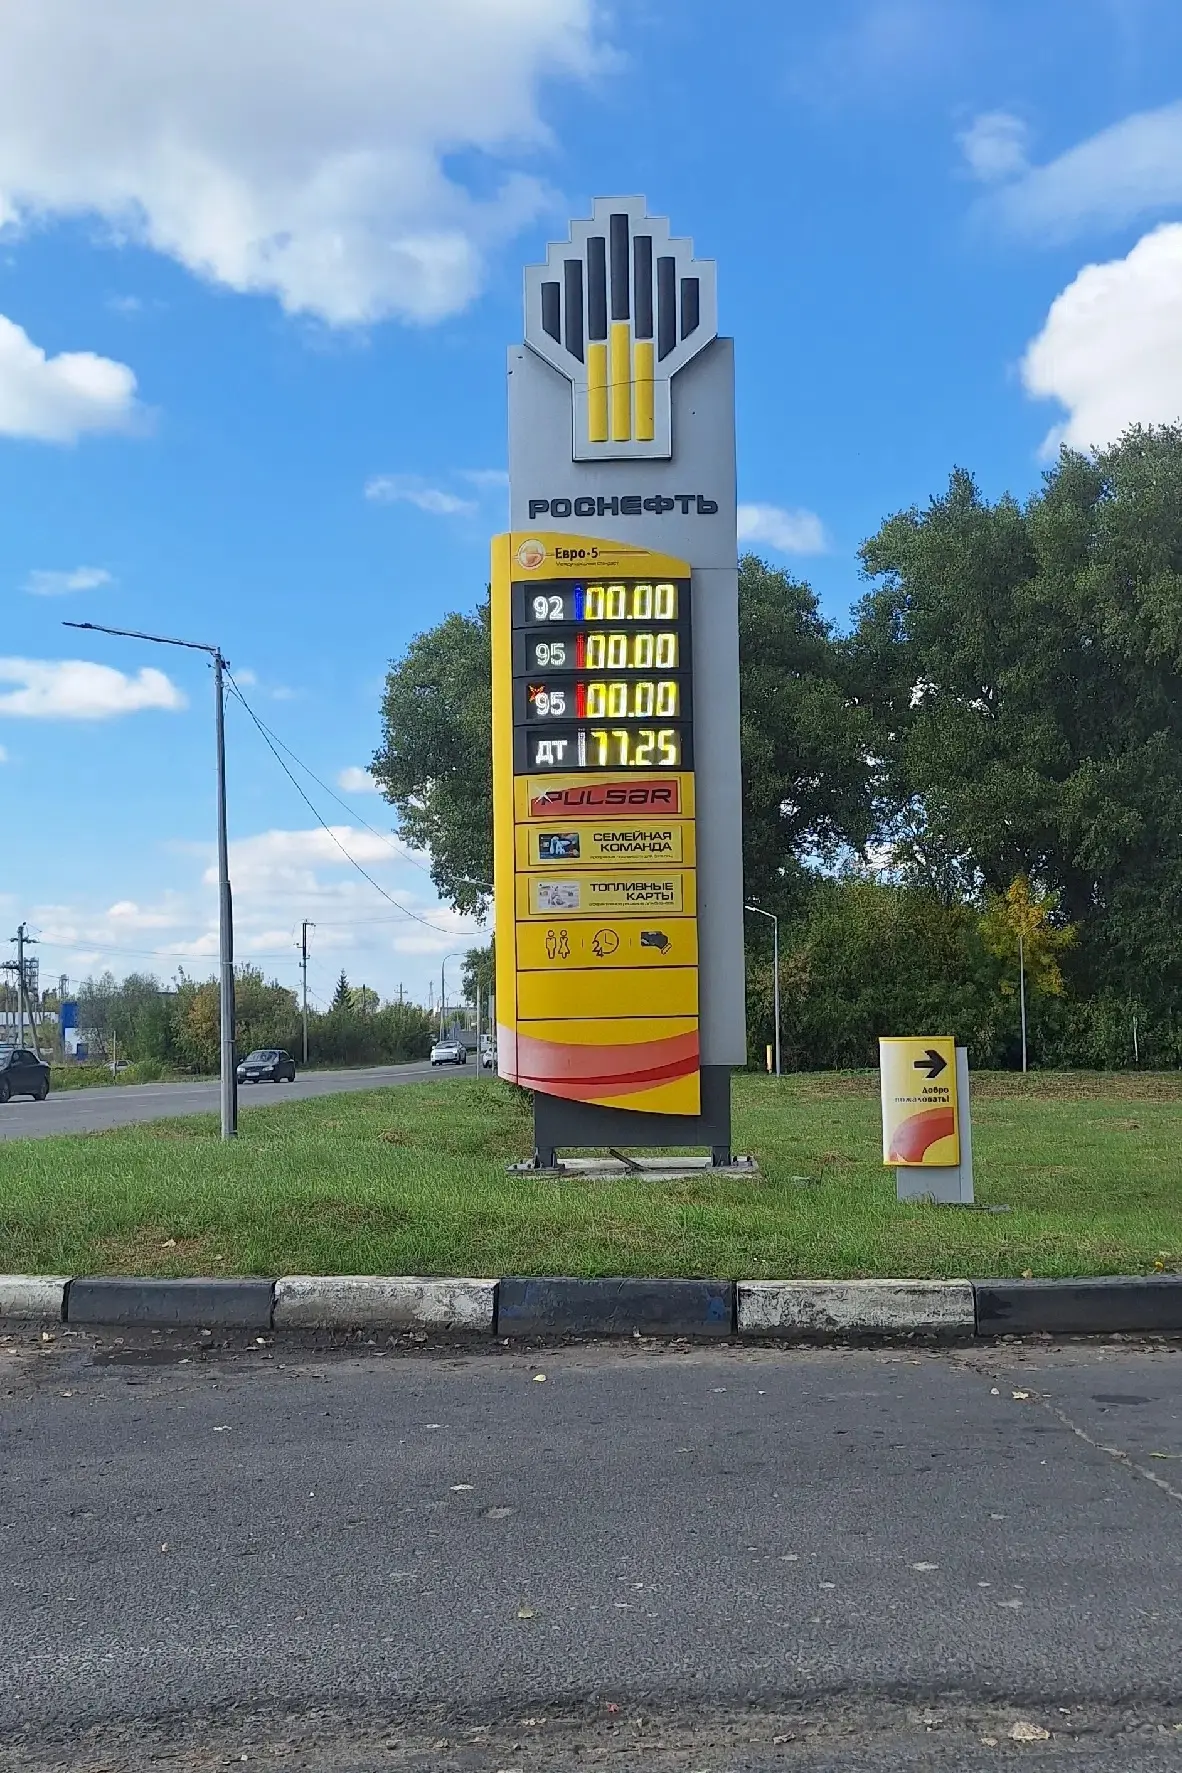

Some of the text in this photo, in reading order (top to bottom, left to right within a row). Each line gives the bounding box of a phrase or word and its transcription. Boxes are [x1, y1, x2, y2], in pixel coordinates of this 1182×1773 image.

[528, 494, 718, 519] РОСНЕФТЬ
[533, 584, 675, 620] 92 00.00
[535, 633, 675, 669] 95 00.00
[535, 681, 676, 718] 95 00.00
[535, 729, 676, 766] ДТ 77.25
[593, 830, 672, 842] СЕМЕЙНАЯ
[600, 842, 672, 852] КОМАНДА
[589, 882, 674, 892] ТОПЛИВНЫЕ
[626, 891, 674, 901] КАРТЫ
[922, 1086, 950, 1095] Добро
